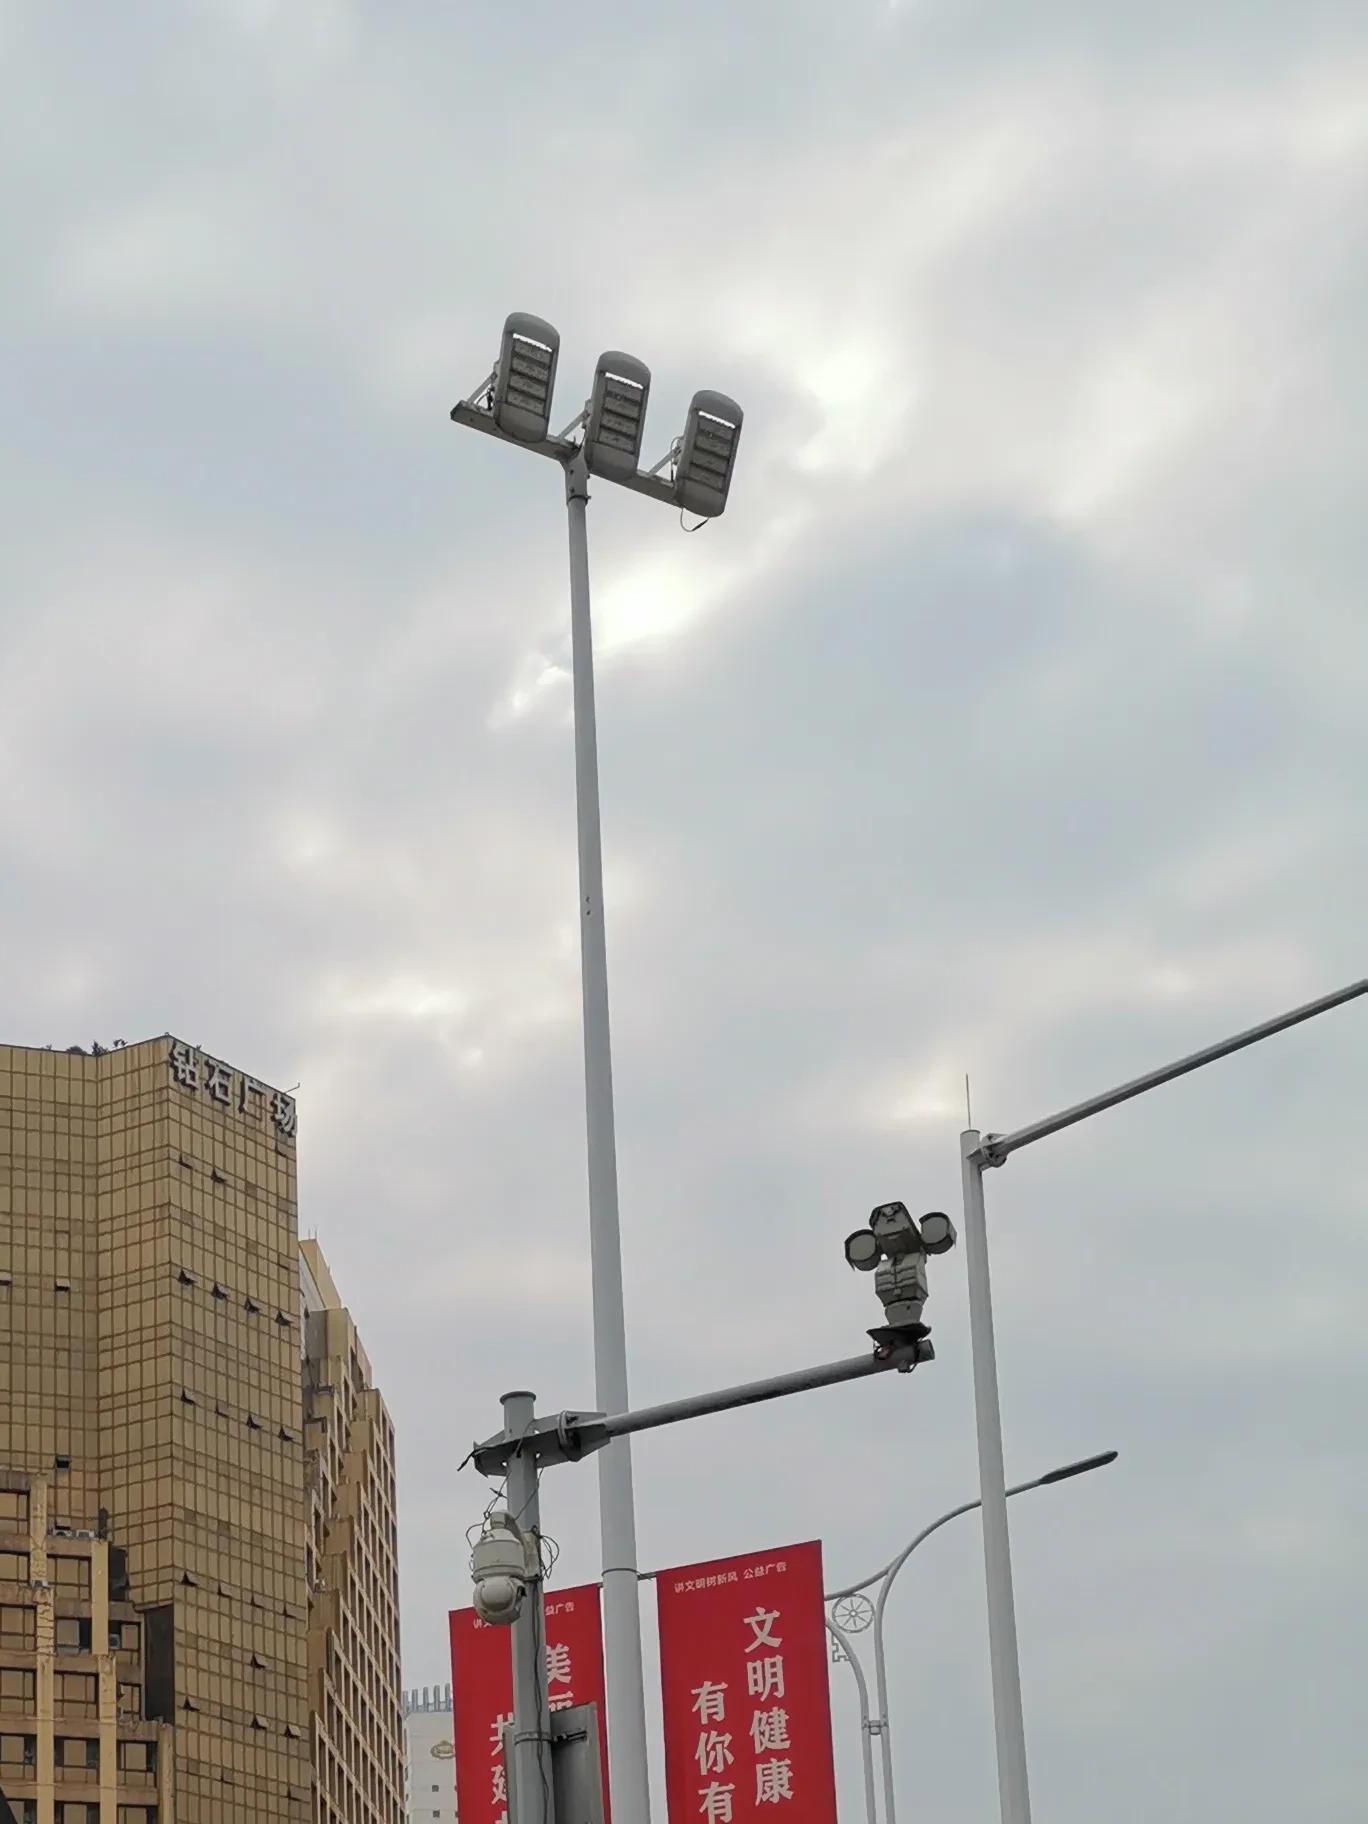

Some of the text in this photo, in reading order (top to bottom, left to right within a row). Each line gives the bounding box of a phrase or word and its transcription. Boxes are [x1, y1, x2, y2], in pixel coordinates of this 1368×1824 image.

[674, 1561, 787, 1594] 讲文明树新风 公益广告
[544, 1601, 575, 1616] 益广告
[744, 1606, 795, 1807] 文明健康
